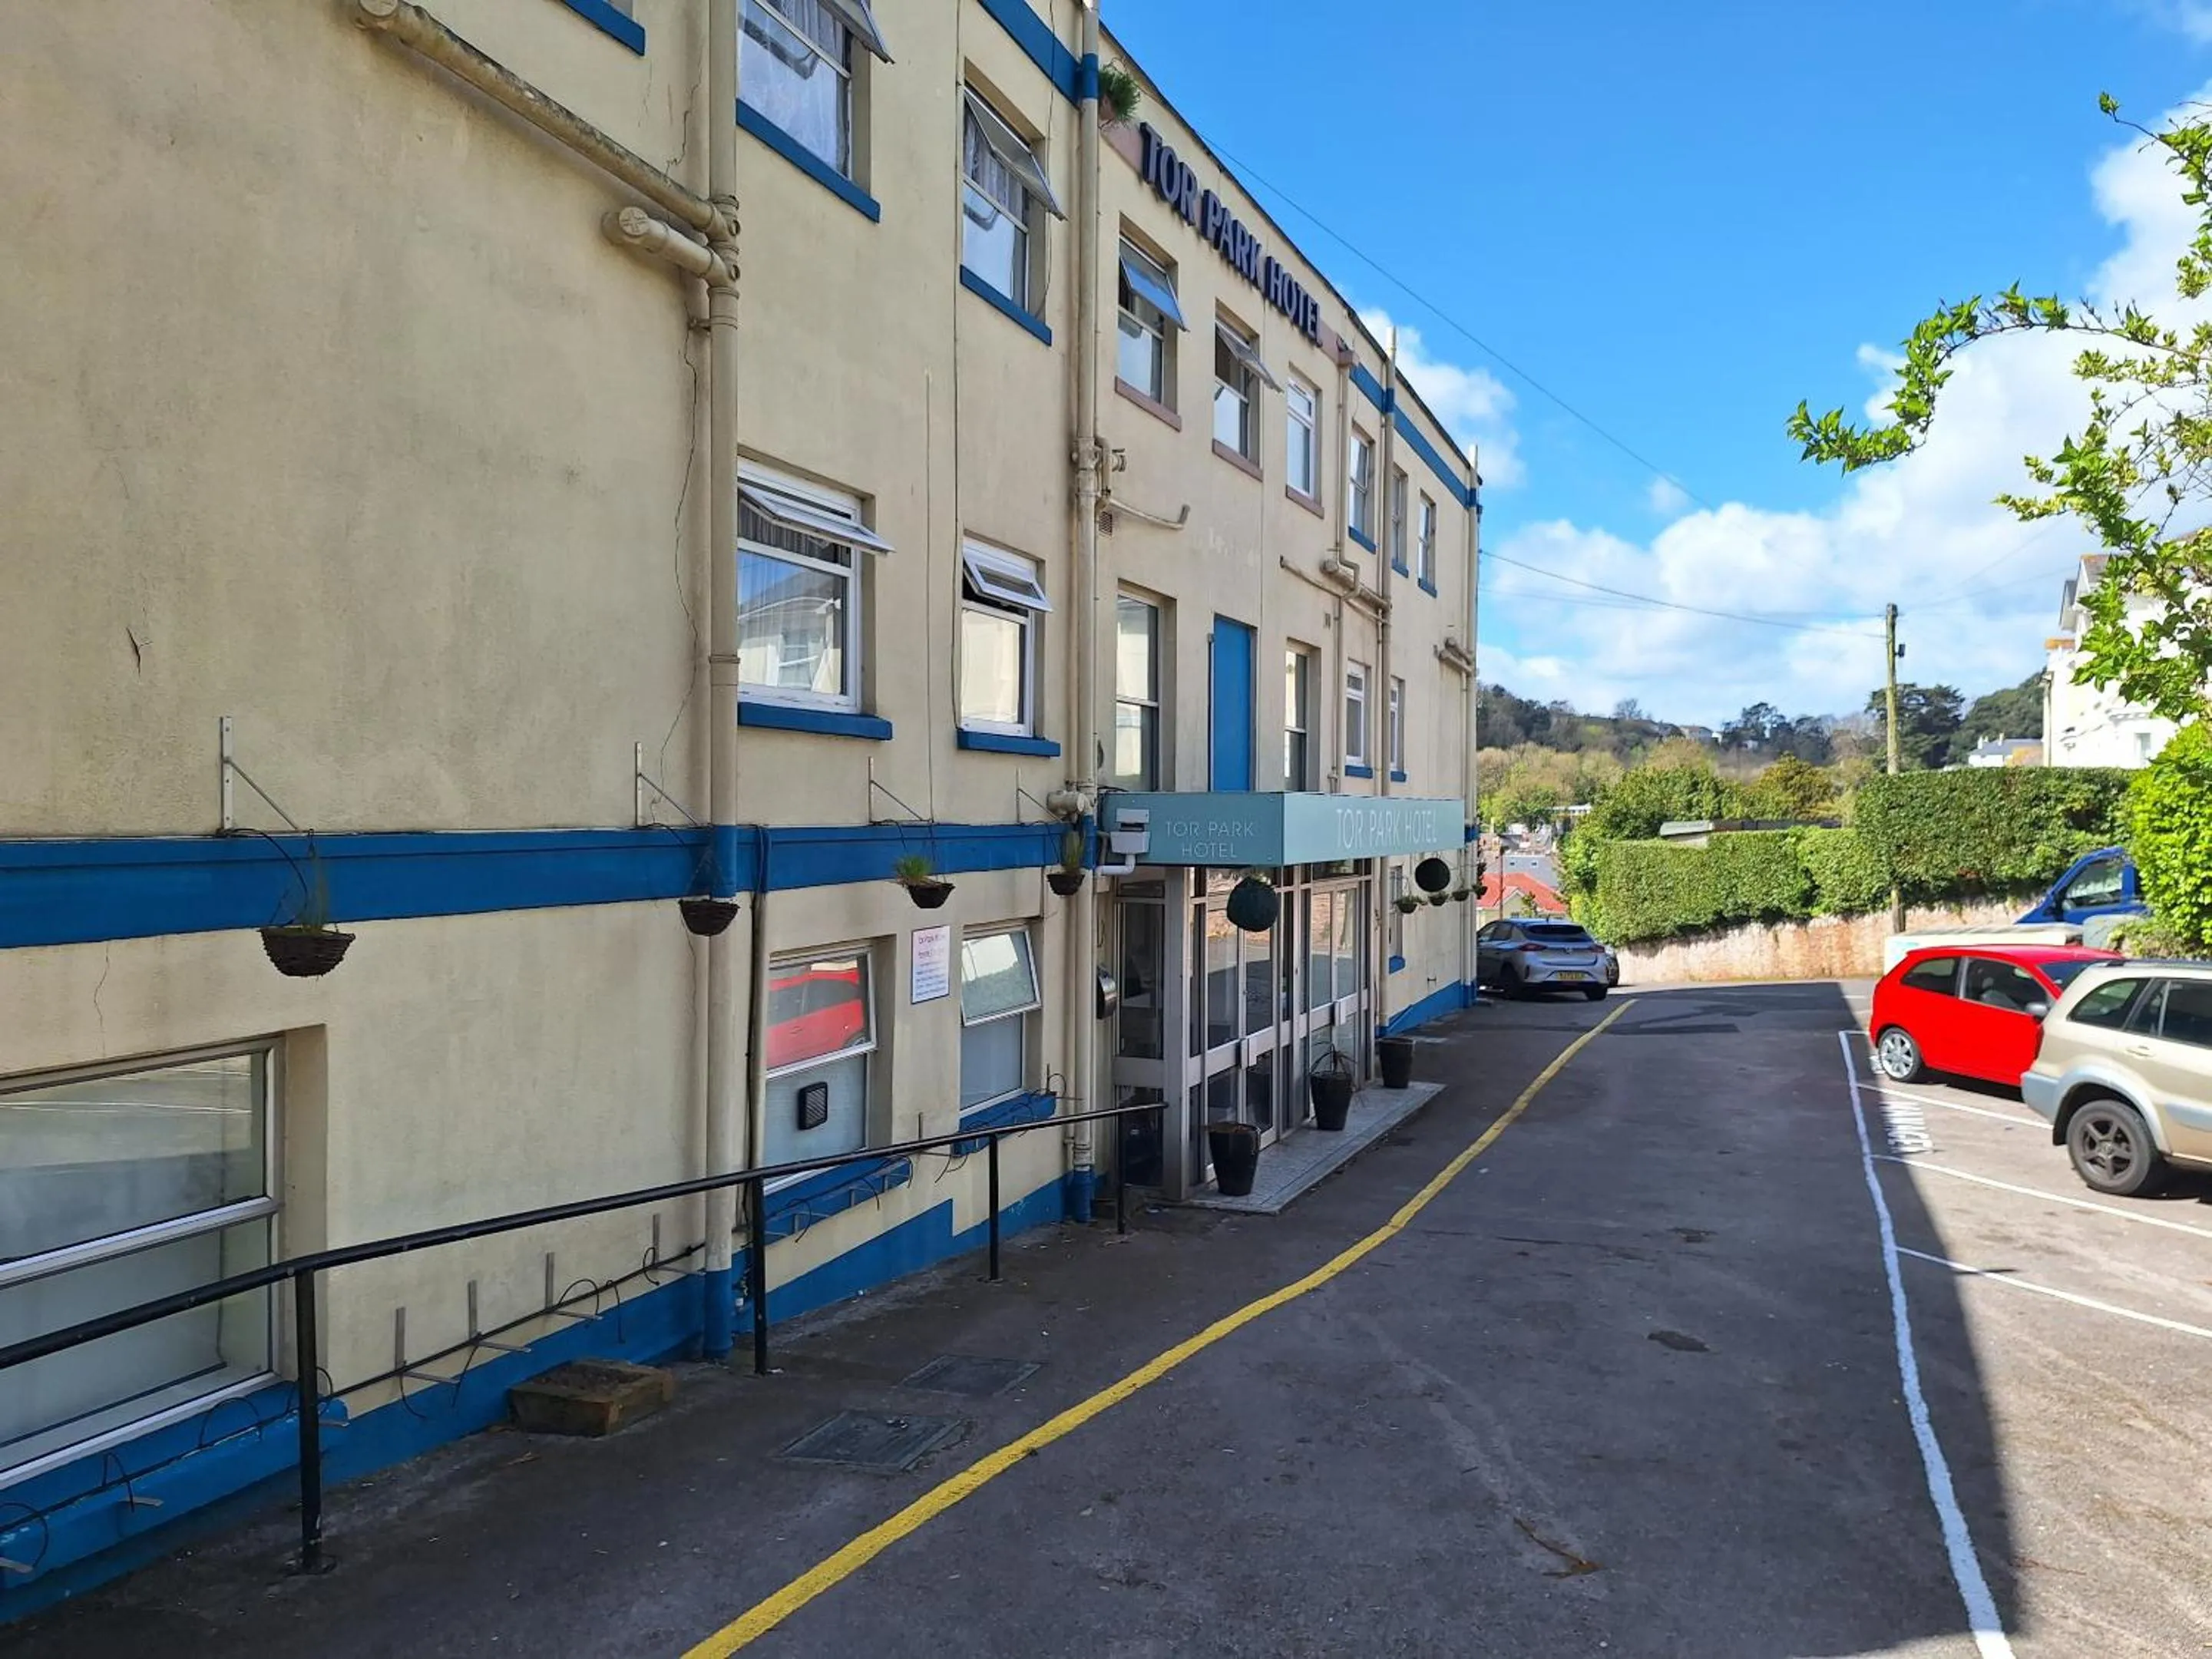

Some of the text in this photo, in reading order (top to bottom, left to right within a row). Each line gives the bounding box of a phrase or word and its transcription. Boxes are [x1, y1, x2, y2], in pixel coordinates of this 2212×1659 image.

[1139, 121, 1198, 227] TOR
[1200, 189, 1264, 292] PARK
[1166, 821, 1255, 838] TOR PARK
[1336, 808, 1438, 850] TOR PARK HOTEL
[1182, 841, 1238, 858] HOTEL
